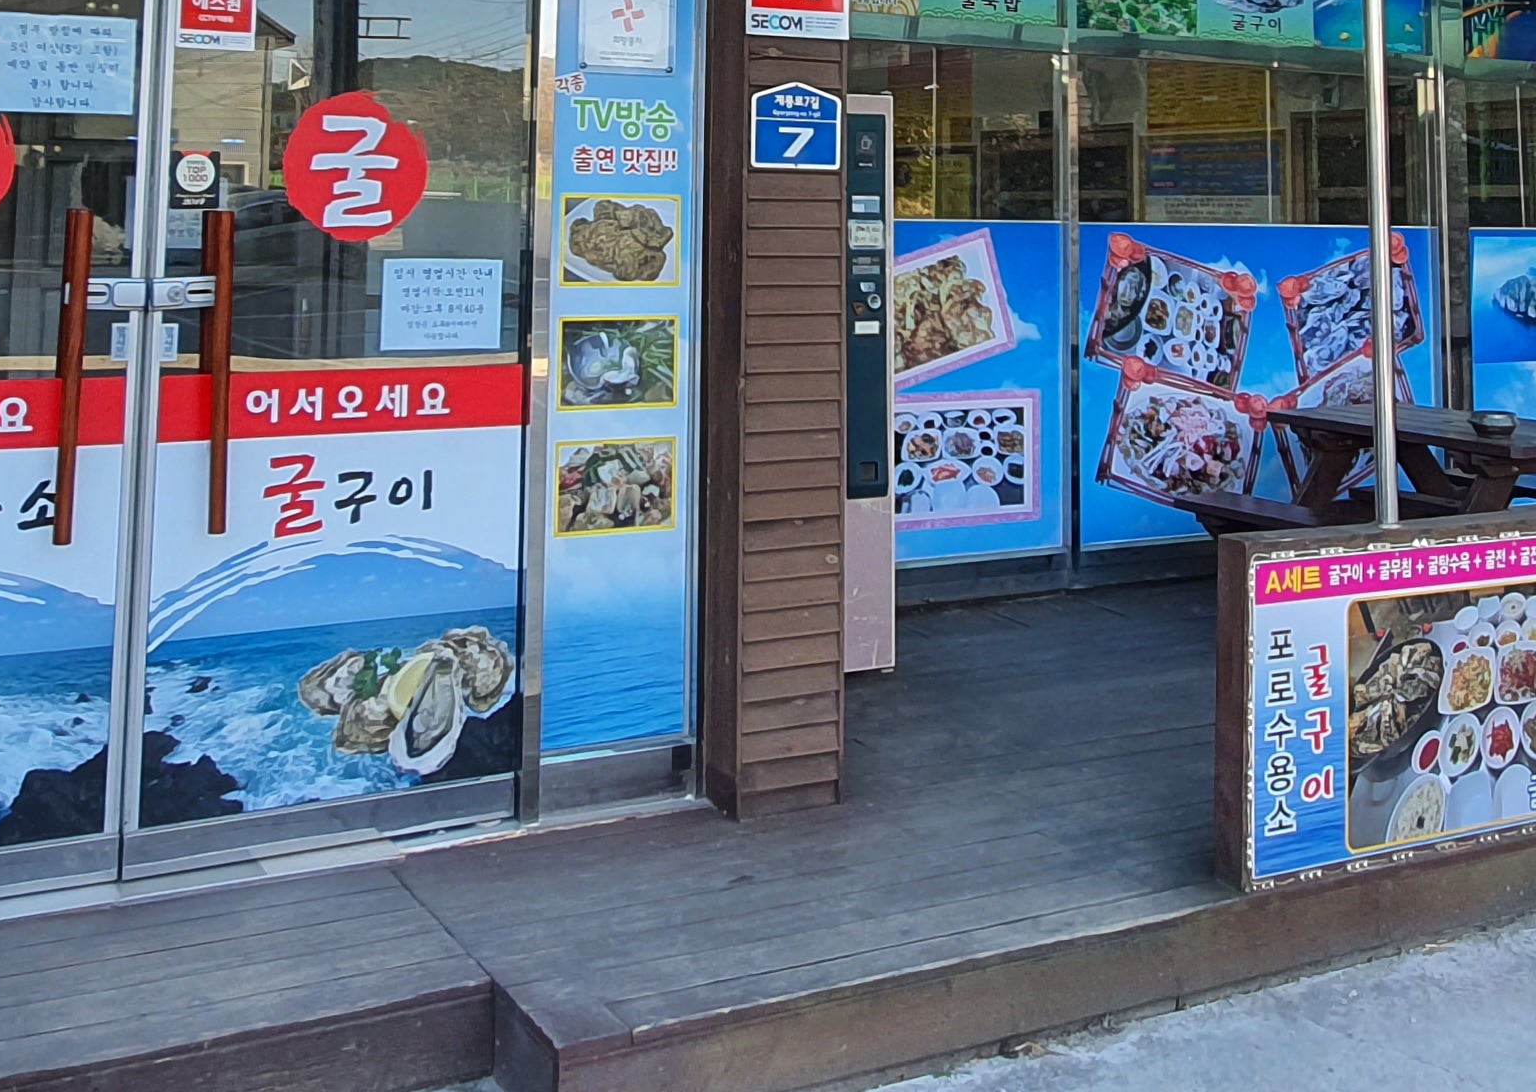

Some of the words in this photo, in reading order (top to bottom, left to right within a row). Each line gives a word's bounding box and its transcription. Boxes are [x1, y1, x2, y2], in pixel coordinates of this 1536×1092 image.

[751, 14, 802, 31] SECOM
[1231, 14, 1282, 33] 굴구이
[179, 34, 221, 44] SECOM
[556, 74, 584, 92] 각종
[573, 99, 676, 139] TV방송
[778, 127, 814, 158] 7
[187, 166, 207, 174] TOP
[310, 115, 399, 228] 굴
[573, 148, 615, 172] 출연
[623, 150, 677, 173] 맛집!!
[183, 174, 208, 182] 1000
[423, 268, 466, 280] 영업시간
[473, 268, 493, 280] 안내
[245, 383, 451, 424] 어서오세요
[264, 454, 434, 539] 굴구이
[1265, 566, 1322, 594] A세트
[1329, 563, 1363, 586] 굴구이
[1379, 557, 1412, 581] 굴무침
[1428, 553, 1470, 576] 굴탕수육
[1485, 550, 1506, 569] 굴전
[1266, 629, 1296, 834] 포로수용소
[1302, 645, 1333, 800] 굴구이
